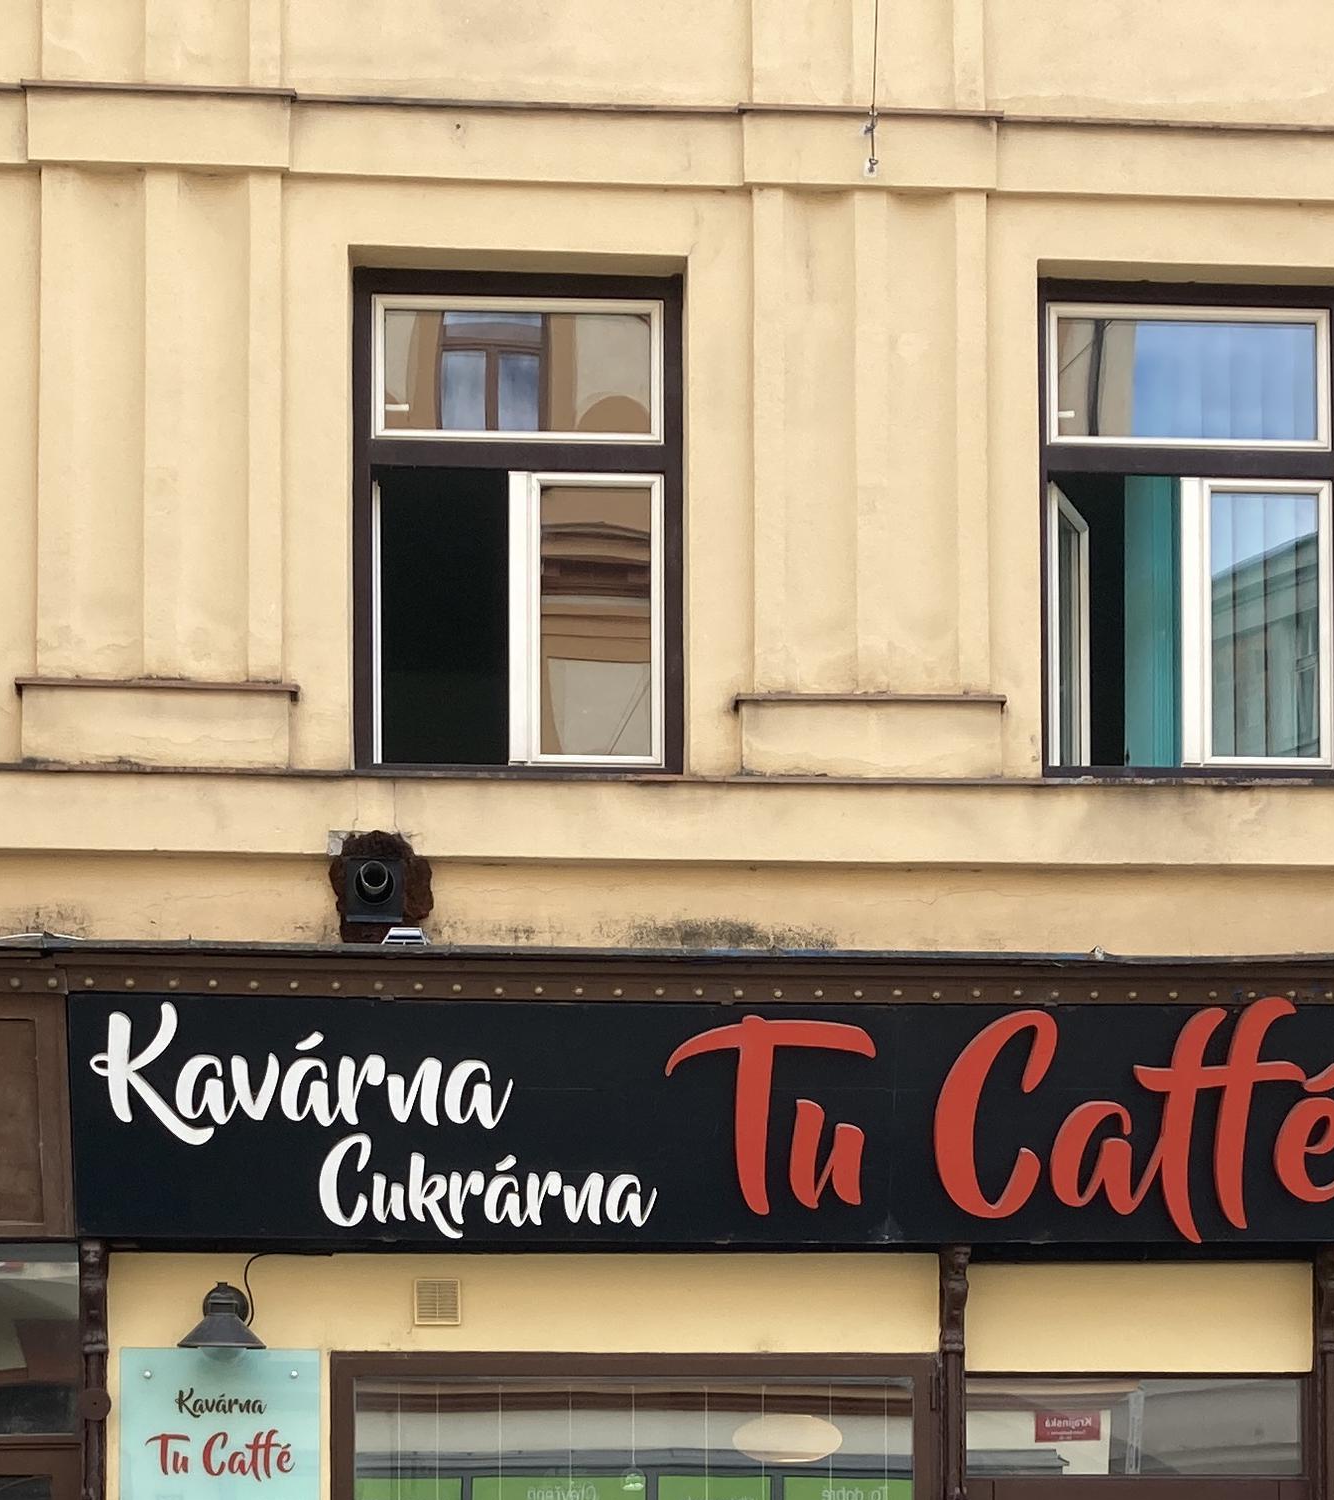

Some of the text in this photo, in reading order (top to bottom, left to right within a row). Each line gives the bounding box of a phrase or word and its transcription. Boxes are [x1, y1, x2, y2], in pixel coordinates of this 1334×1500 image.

[90, 1002, 513, 1145] Kavárna
[665, 1013, 877, 1216] Tu
[319, 1133, 658, 1239] Cukrárna
[145, 1429, 295, 1482] Tu Caffé
[175, 1387, 267, 1418] Kavárna
